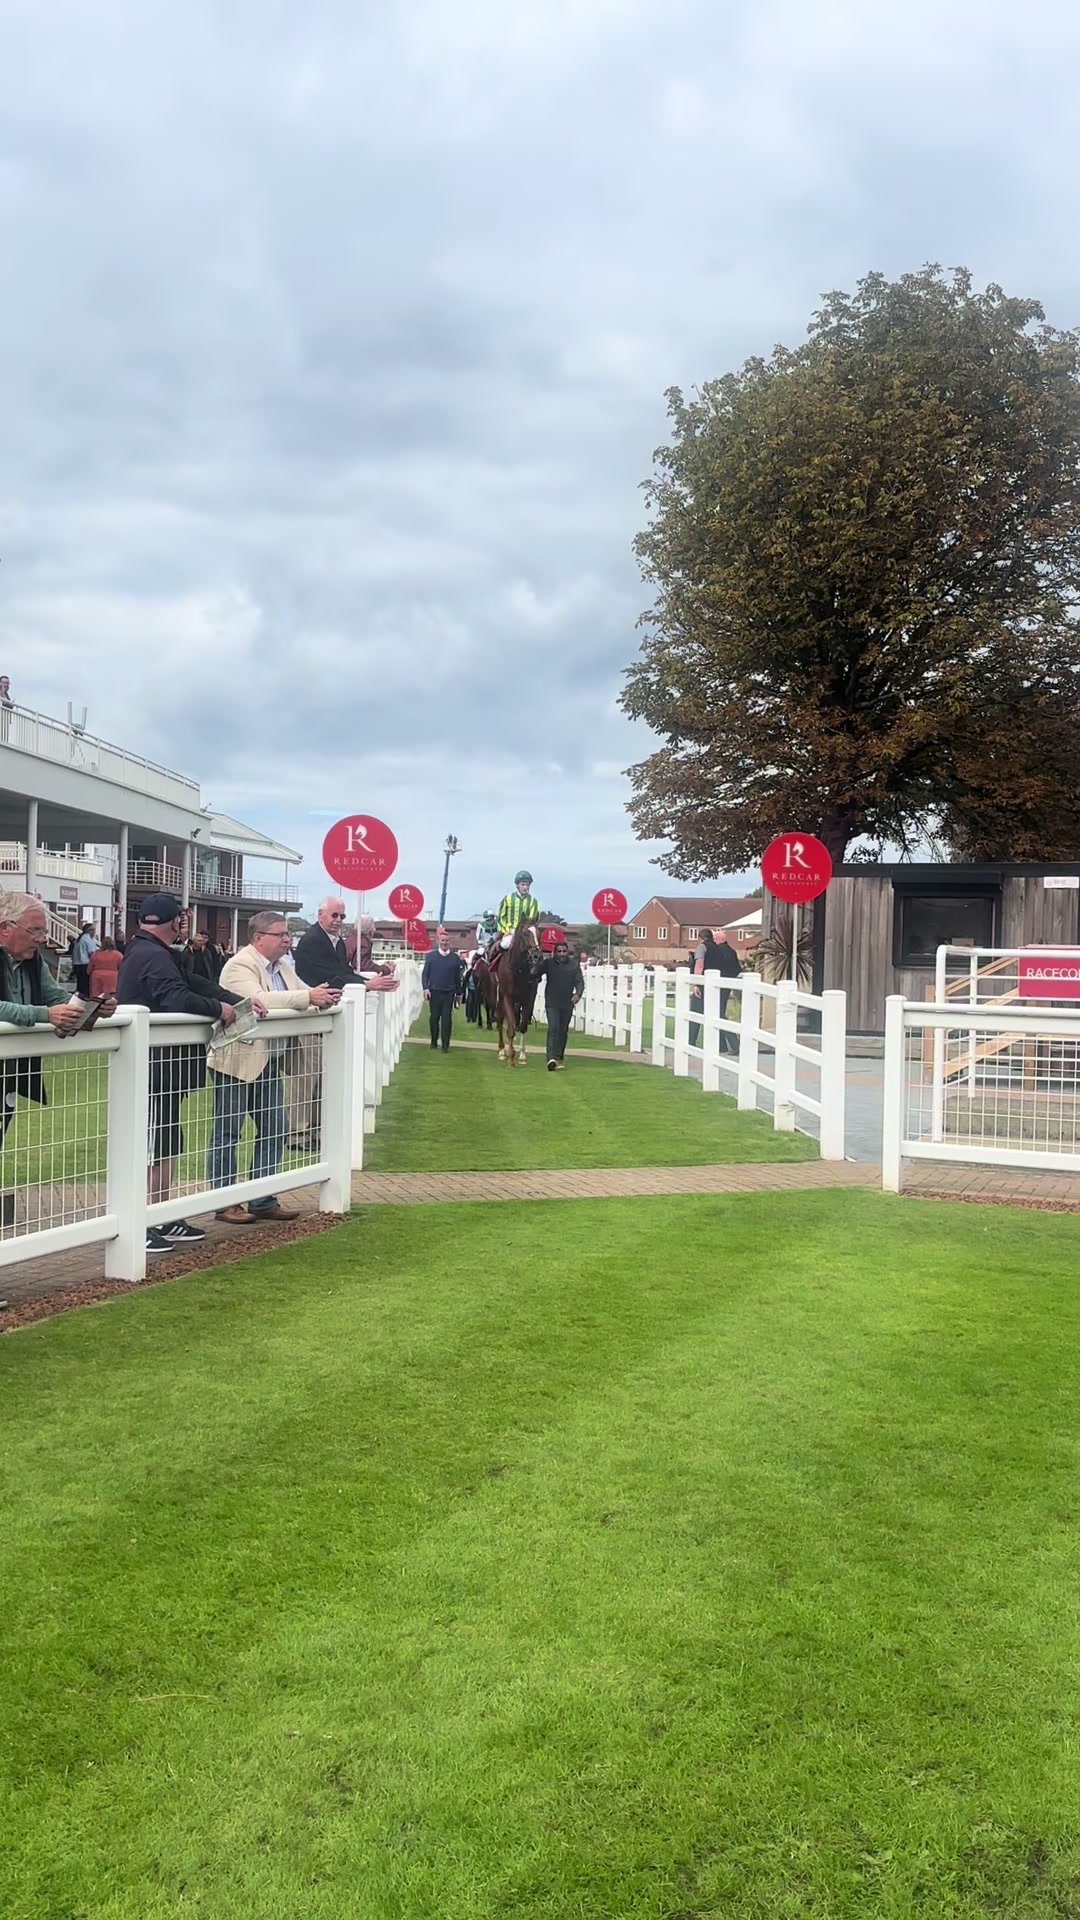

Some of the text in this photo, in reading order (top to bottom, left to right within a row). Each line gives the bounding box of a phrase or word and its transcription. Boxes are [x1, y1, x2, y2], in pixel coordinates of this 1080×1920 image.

[344, 824, 376, 853] R
[782, 840, 813, 869] R
[334, 857, 386, 866] REDCAR
[772, 872, 822, 881] REDCAR
[1026, 967, 1080, 980] RACECO
